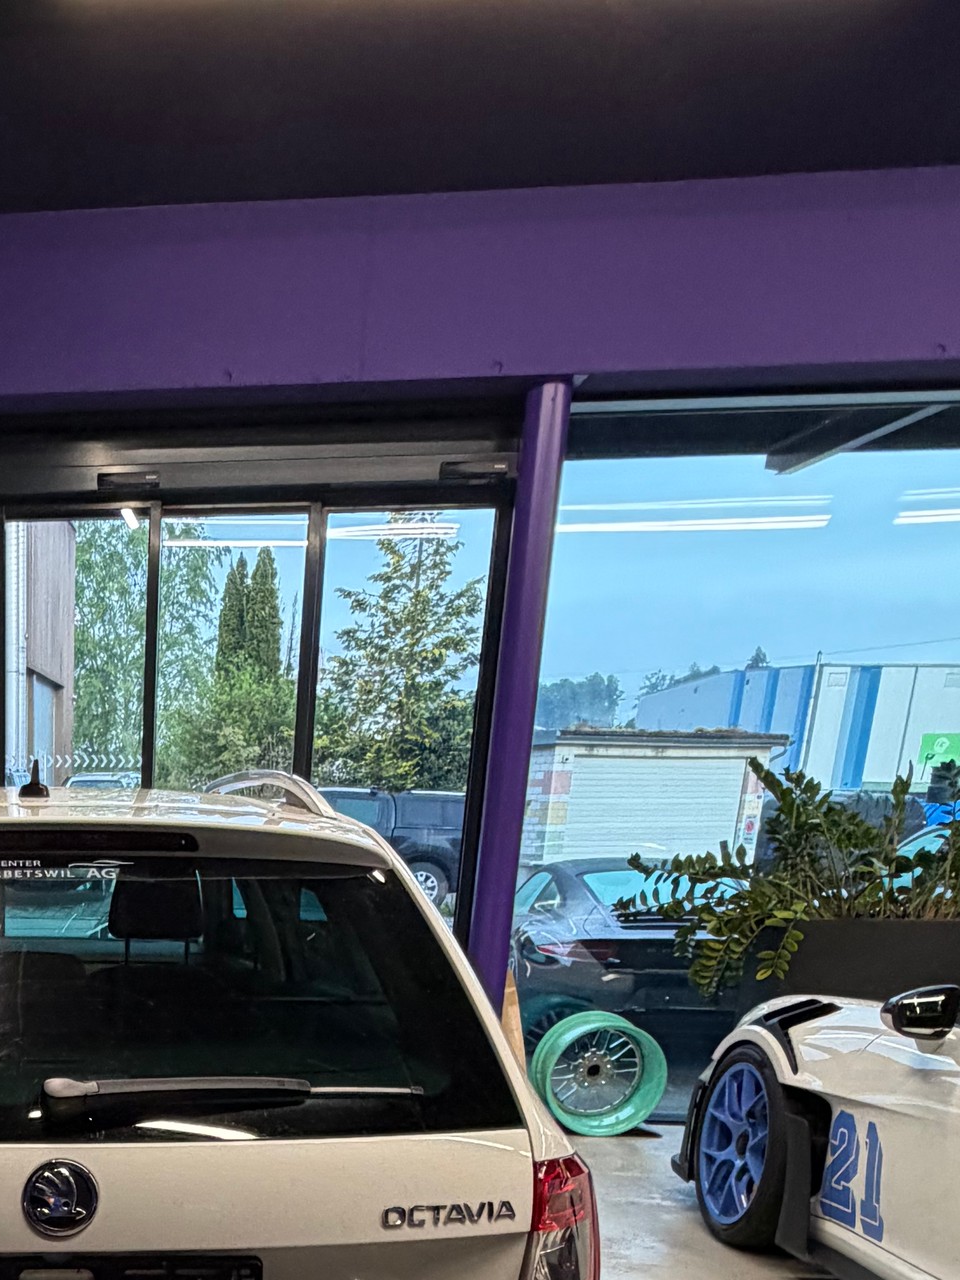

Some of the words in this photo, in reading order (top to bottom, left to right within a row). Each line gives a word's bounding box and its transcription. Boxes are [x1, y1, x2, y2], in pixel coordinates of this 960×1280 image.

[87, 867, 117, 879] AG
[819, 1109, 885, 1243] 21
[381, 1200, 517, 1230] OCTAVIA
